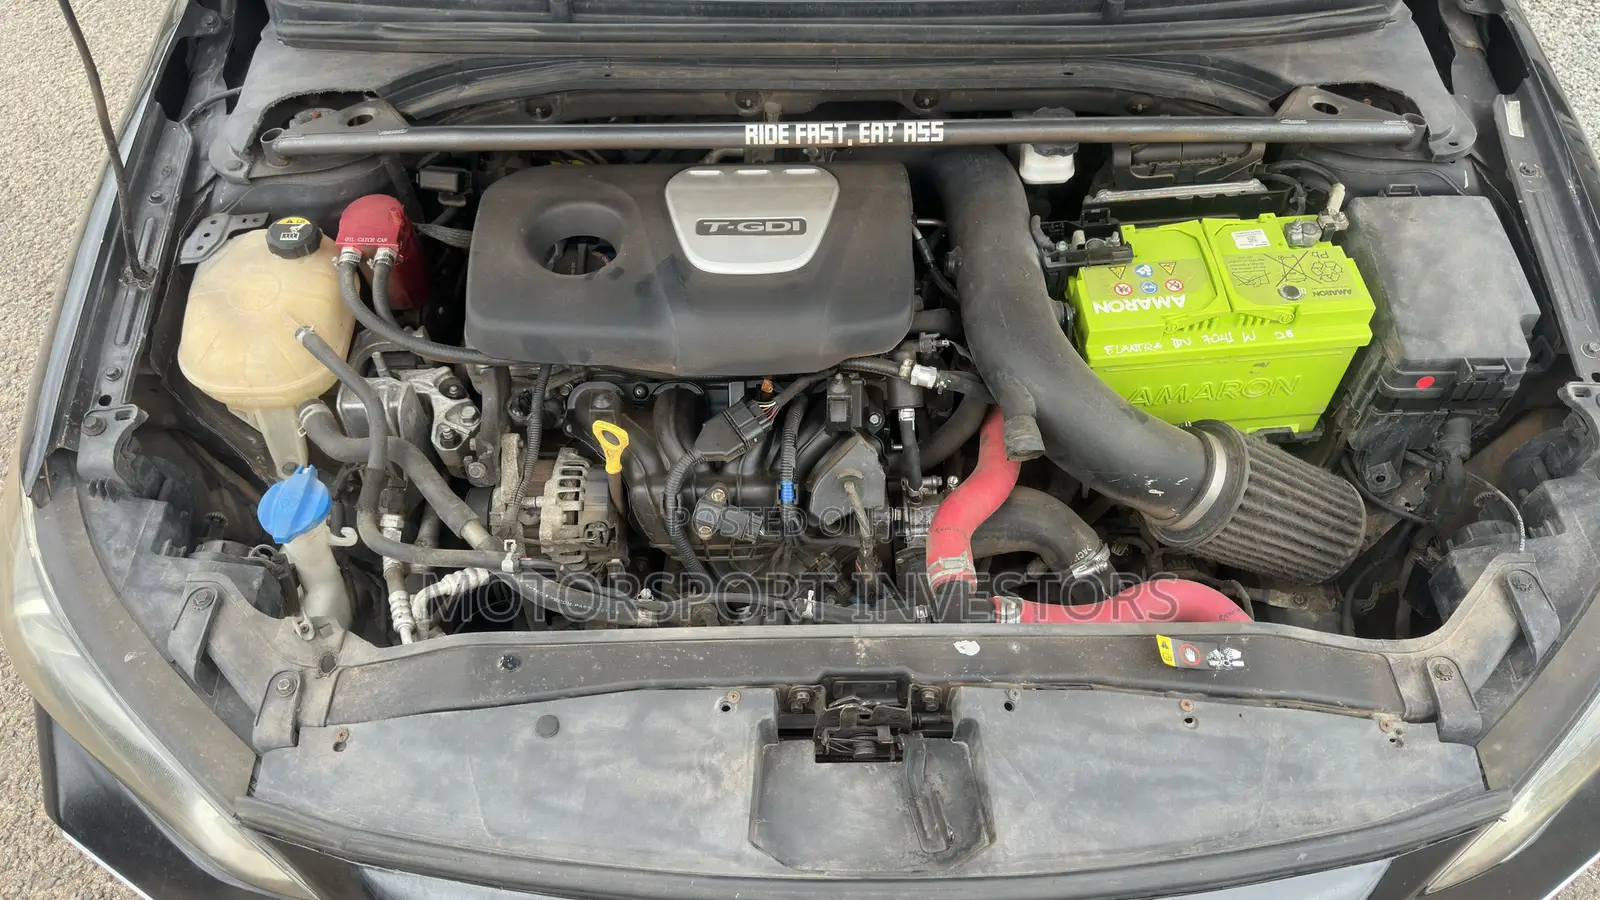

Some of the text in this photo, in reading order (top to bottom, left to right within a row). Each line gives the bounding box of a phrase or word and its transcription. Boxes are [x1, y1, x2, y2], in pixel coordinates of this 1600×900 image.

[745, 123, 789, 145] RIDE
[795, 122, 853, 147] FAST,
[903, 121, 944, 143] ASS
[703, 221, 800, 233] T-GDI
[1311, 250, 1329, 259] Pb
[1312, 287, 1352, 298] AMARON
[1092, 294, 1186, 315] AMARON
[1127, 374, 1302, 407] AMARON
